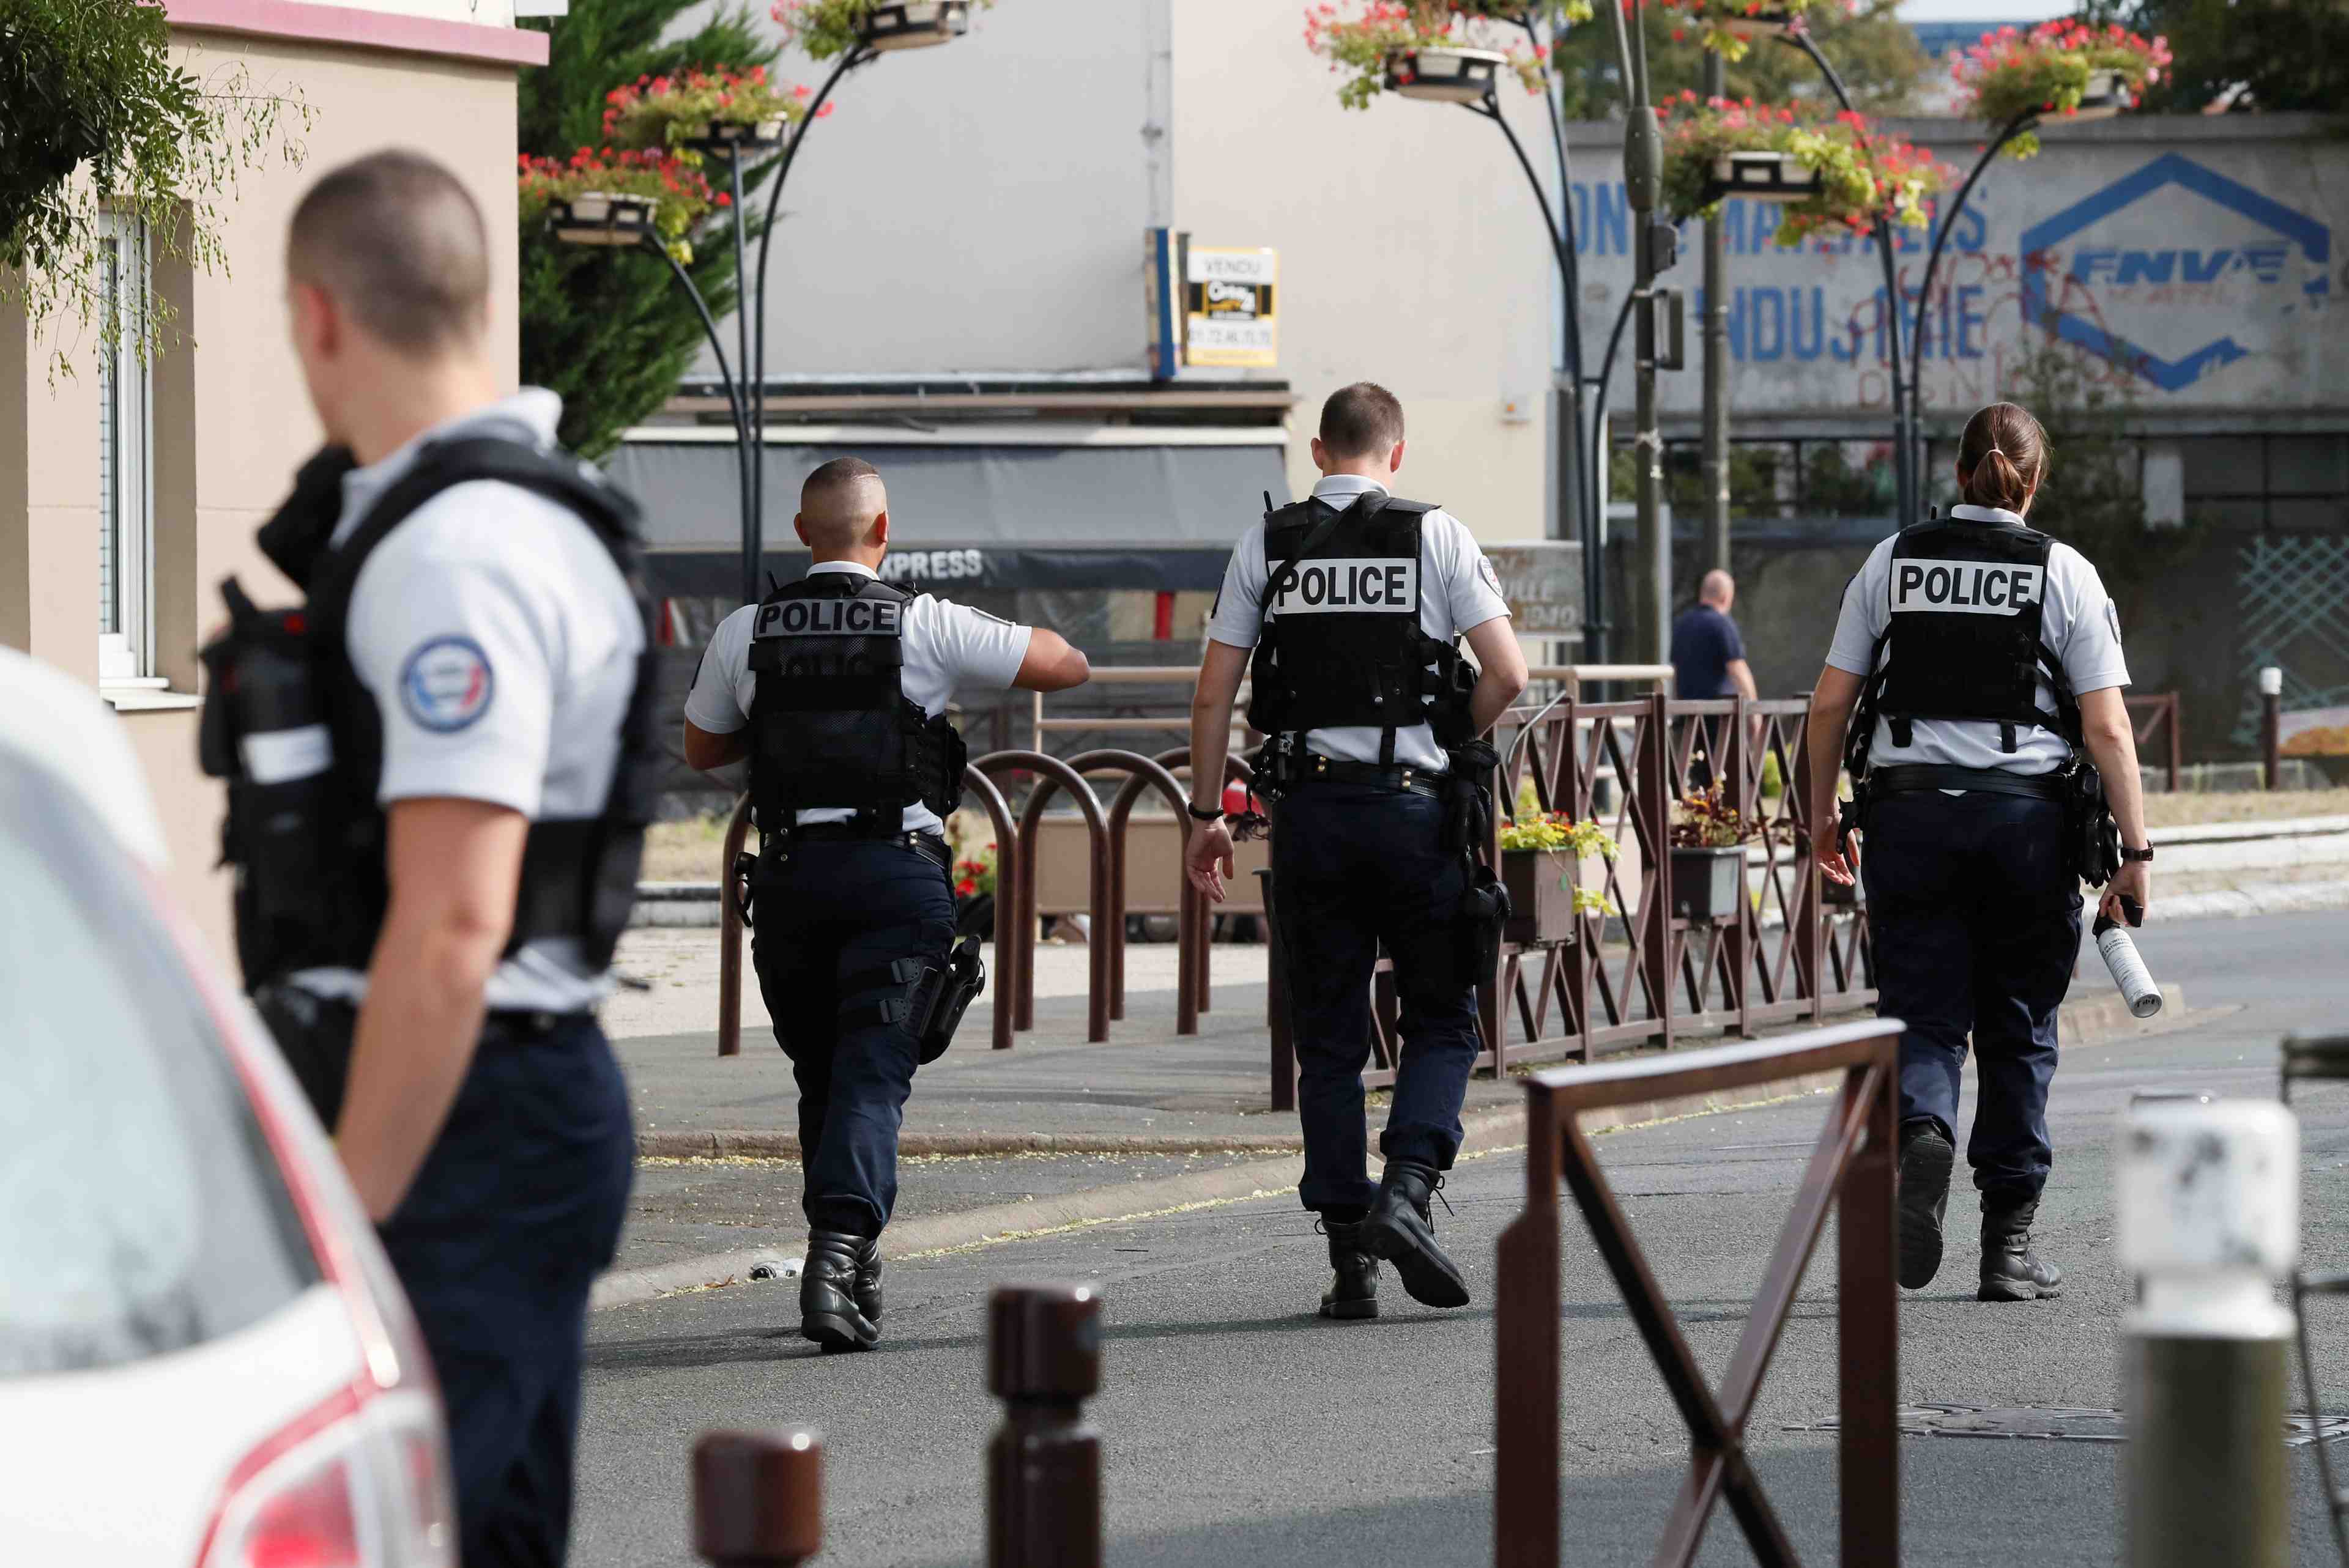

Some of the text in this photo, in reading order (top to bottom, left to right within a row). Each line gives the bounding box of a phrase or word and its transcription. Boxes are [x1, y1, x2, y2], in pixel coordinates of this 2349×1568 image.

[1203, 257, 1261, 274] VENDU
[878, 549, 983, 580] XPRESS
[1277, 566, 1407, 606] POLICE
[1899, 565, 2033, 609] POLICE
[759, 602, 896, 634] POLICE
